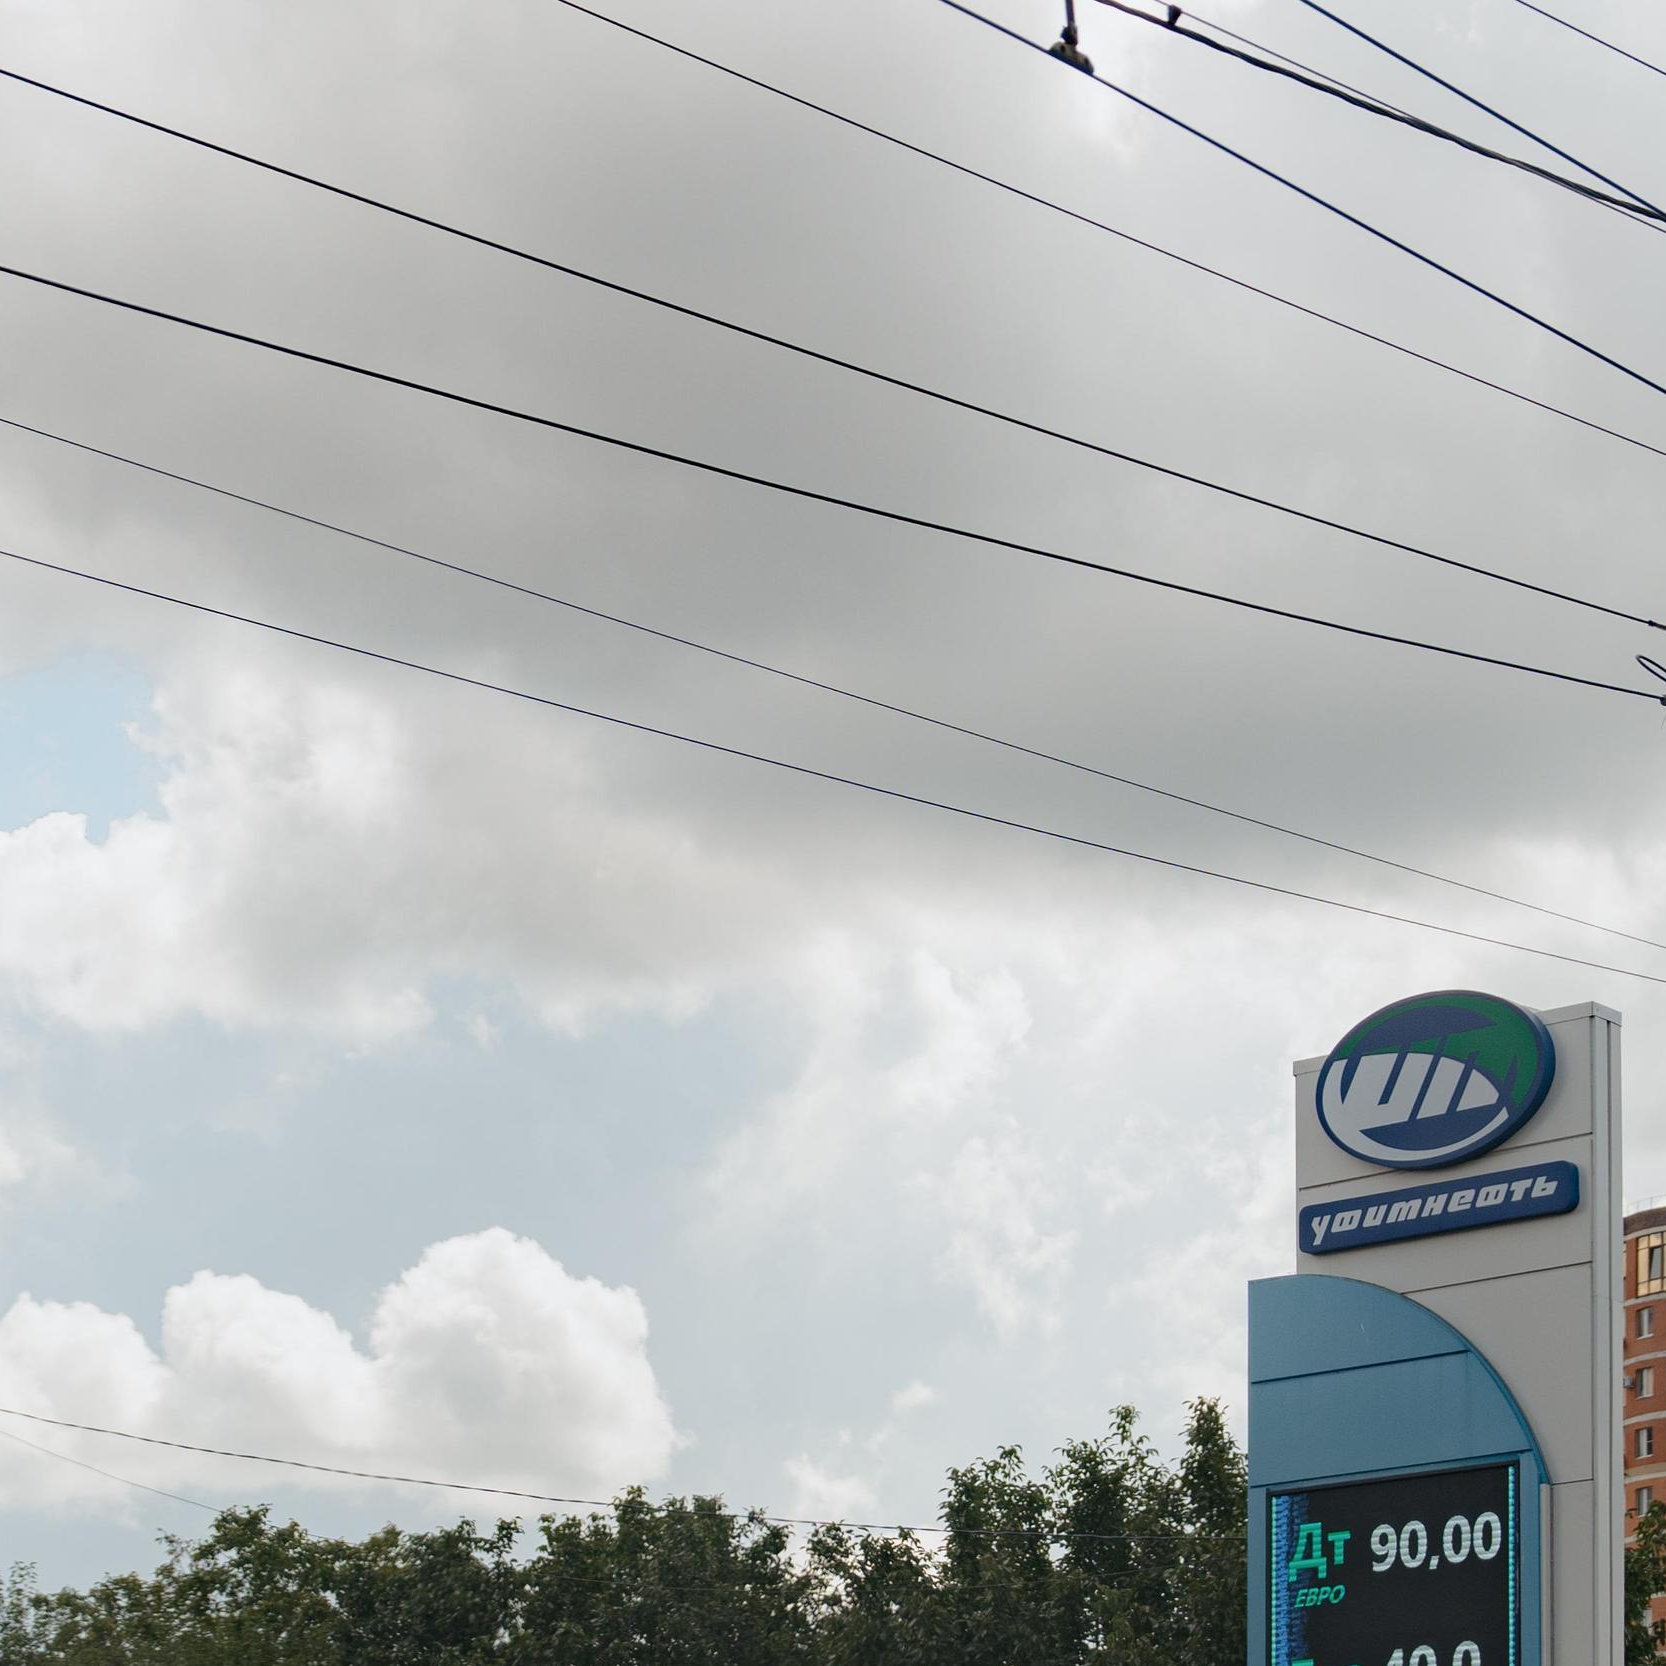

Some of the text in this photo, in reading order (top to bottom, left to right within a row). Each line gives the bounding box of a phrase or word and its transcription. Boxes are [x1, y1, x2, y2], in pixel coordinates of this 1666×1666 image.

[1289, 1511, 1502, 1582] Дт 90,00
[1294, 1585, 1346, 1608] ЕВРО
